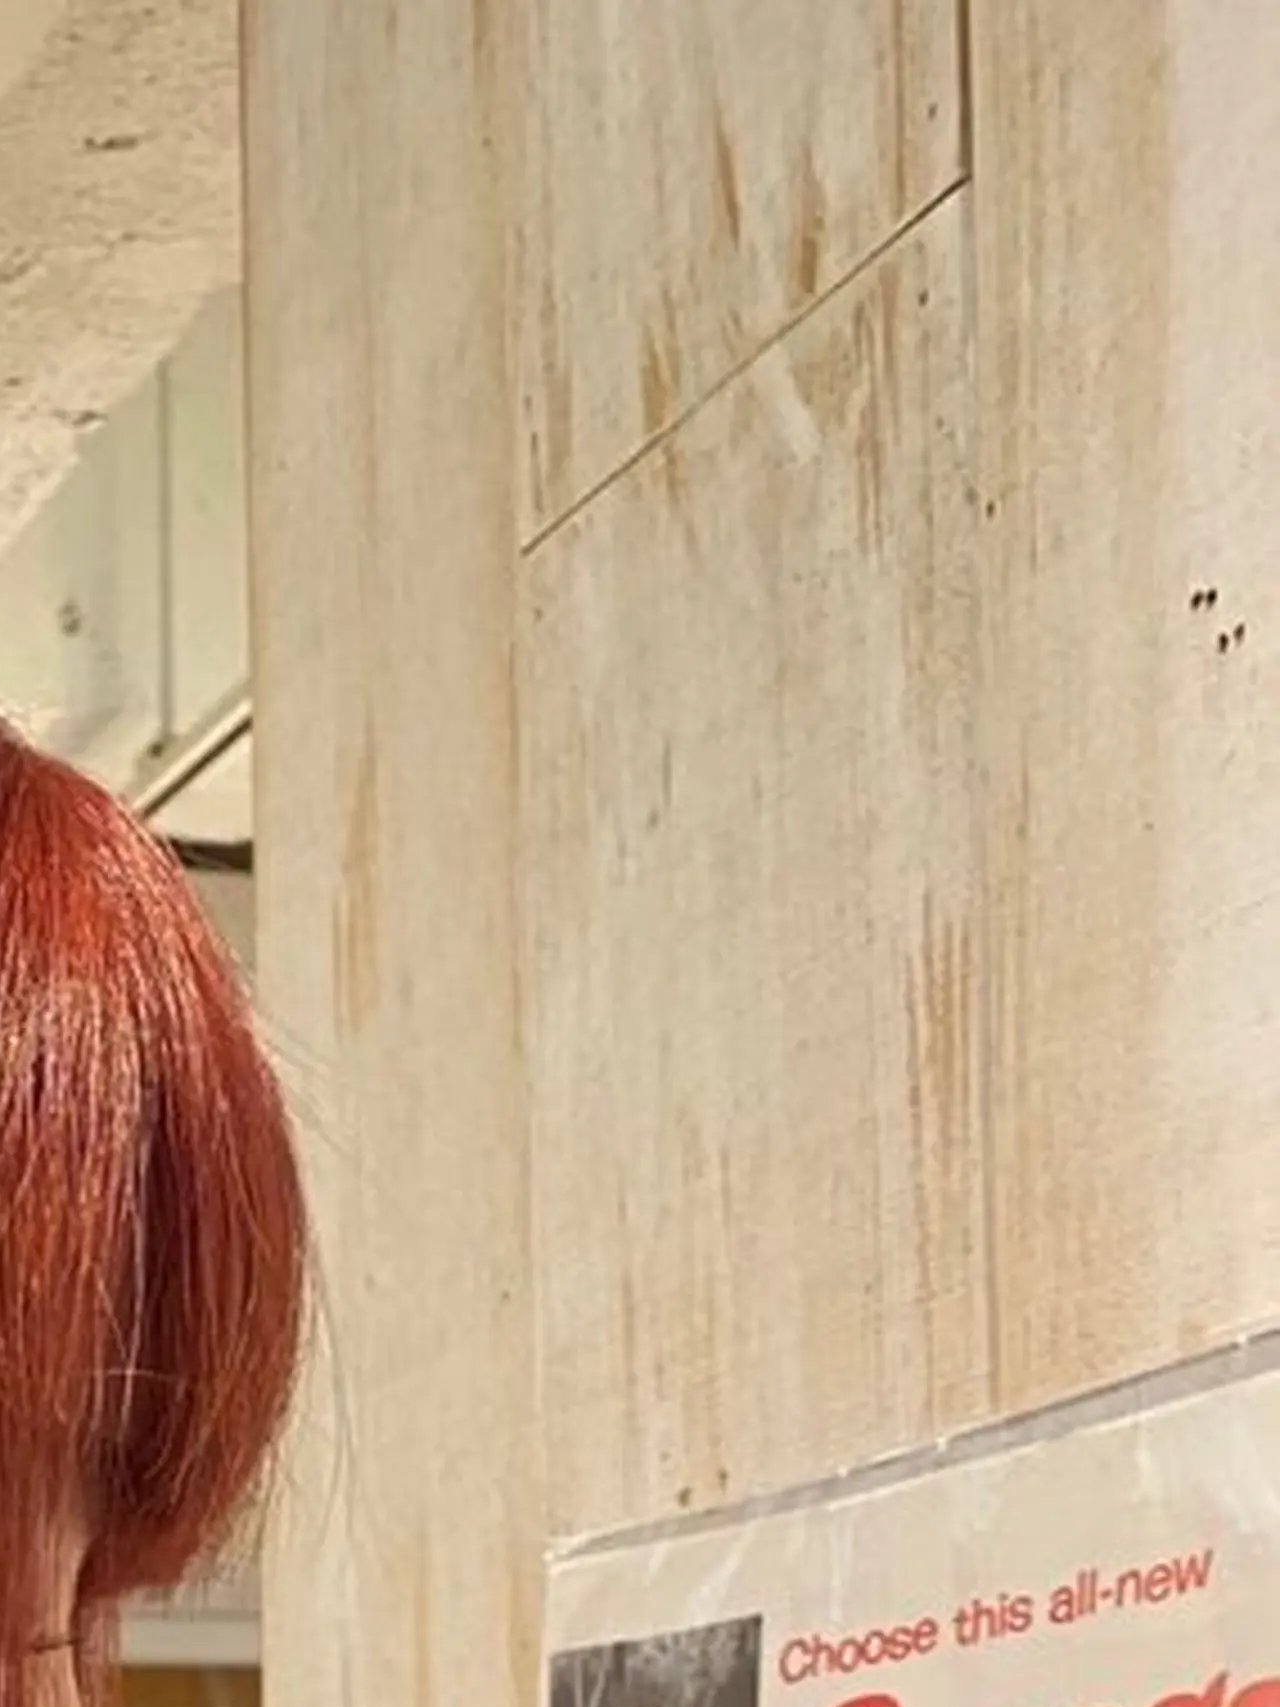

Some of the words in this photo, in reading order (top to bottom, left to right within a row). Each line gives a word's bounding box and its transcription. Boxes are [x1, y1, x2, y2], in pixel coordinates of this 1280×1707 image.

[778, 1615, 939, 1685] Choose
[952, 1593, 1034, 1646] this
[1048, 1548, 1214, 1624] all-new
